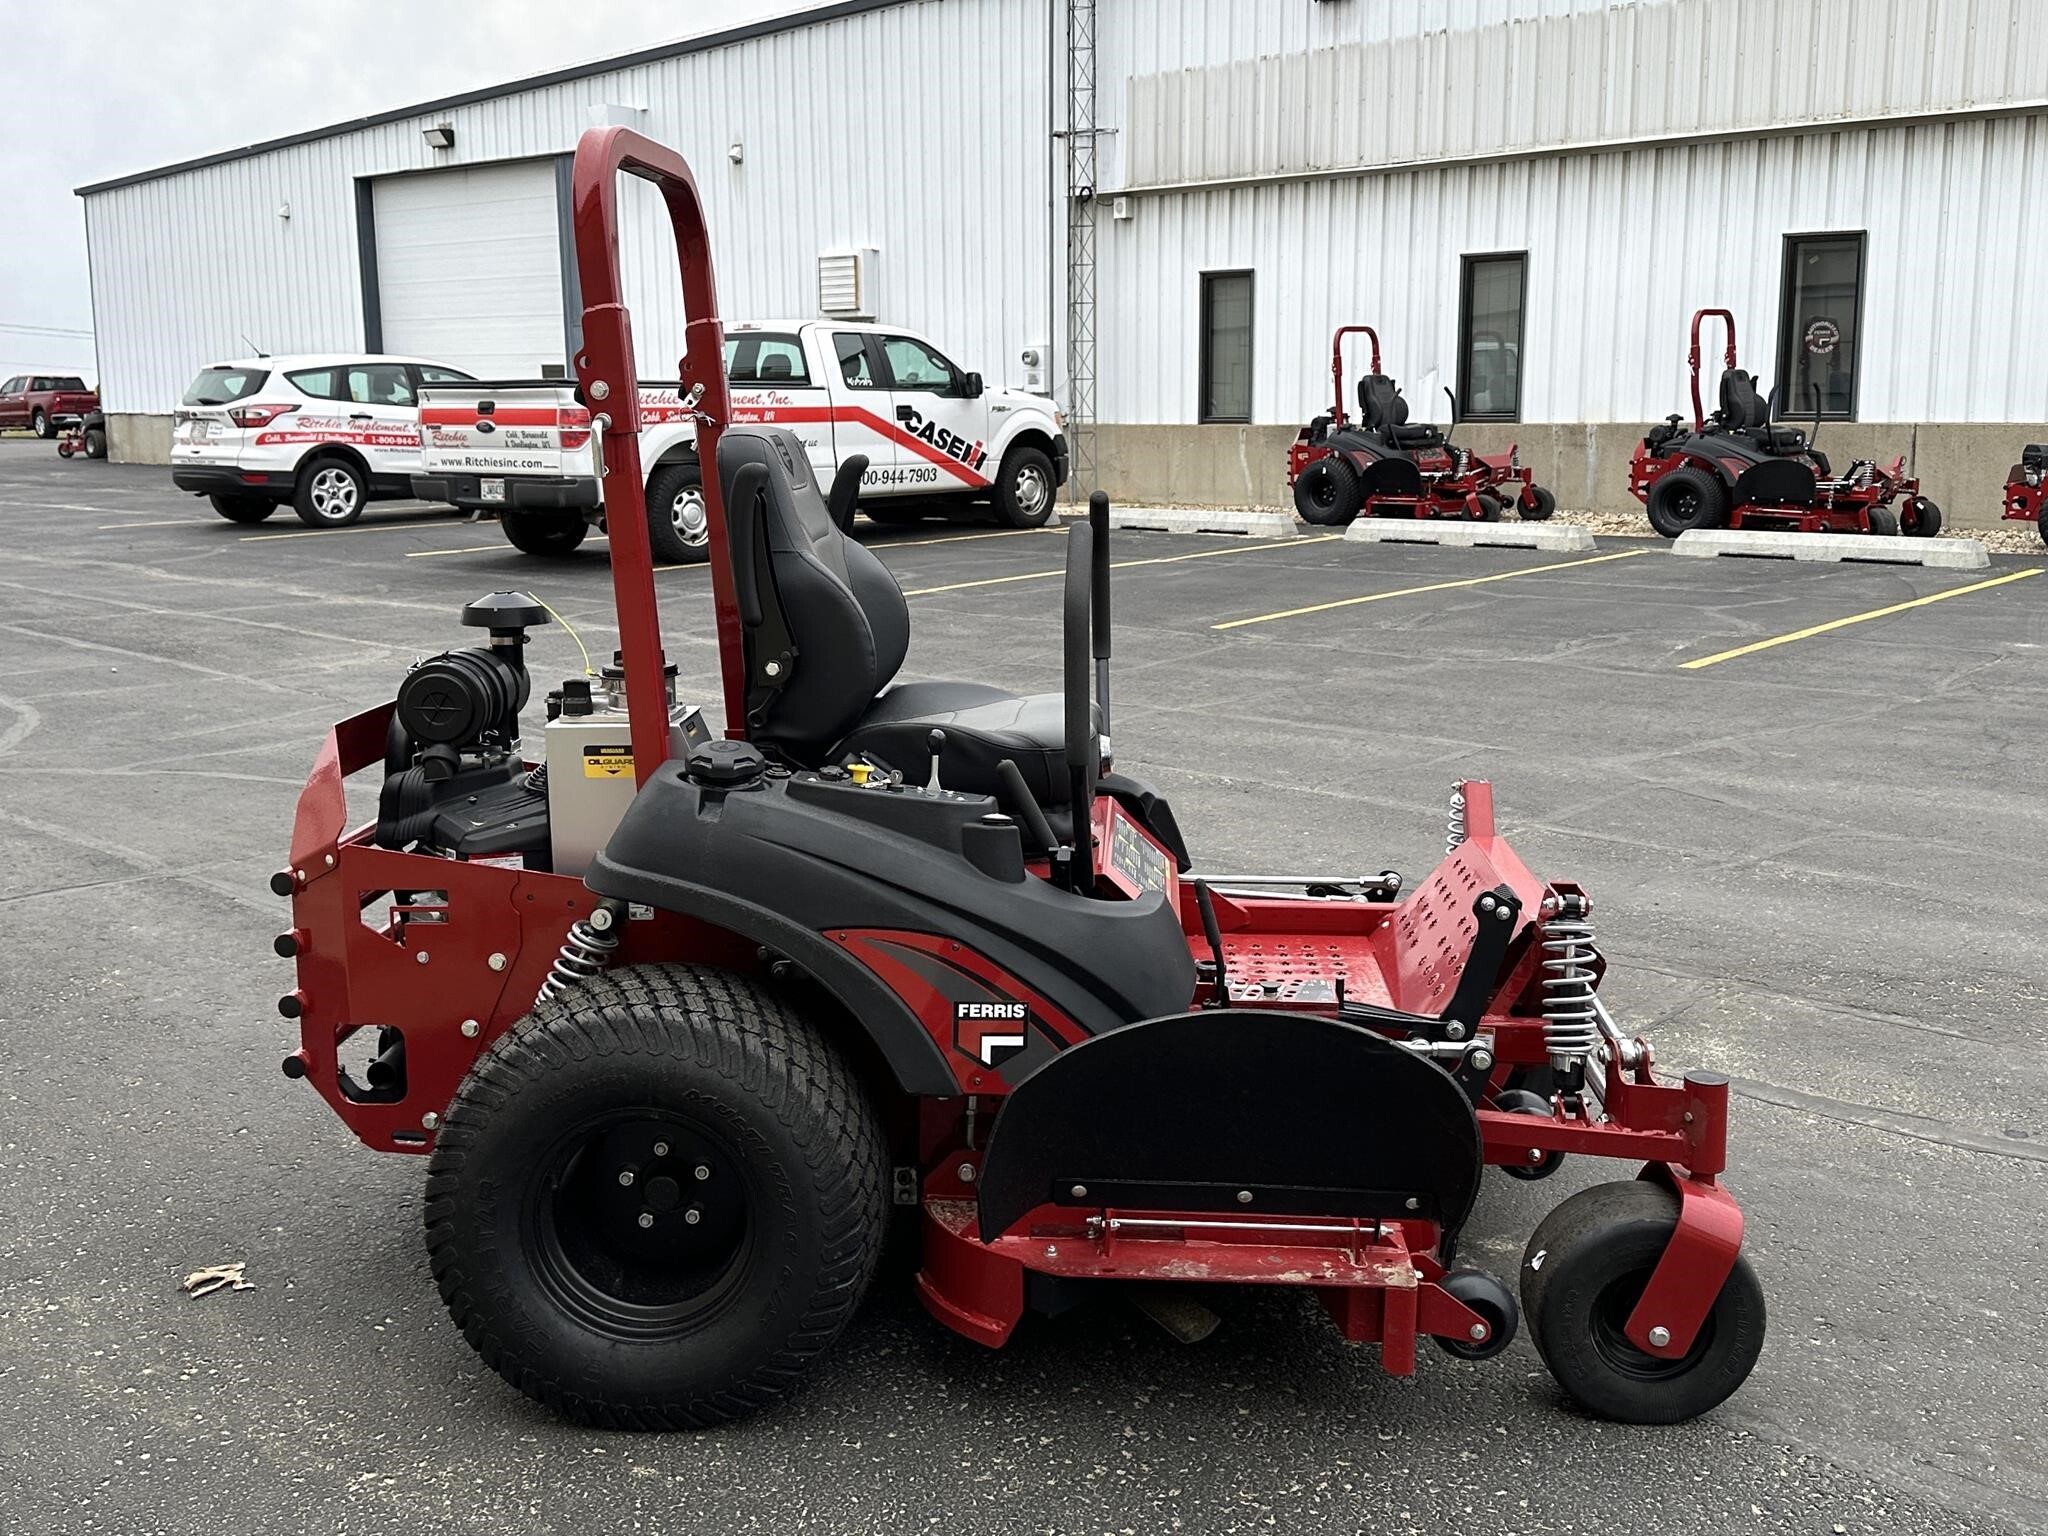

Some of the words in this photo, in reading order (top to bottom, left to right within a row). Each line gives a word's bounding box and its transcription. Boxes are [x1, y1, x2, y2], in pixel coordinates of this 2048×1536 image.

[1808, 321, 1839, 336] AUTHORIZED
[1809, 345, 1834, 354] DEALER
[638, 391, 679, 405] itchie
[767, 391, 793, 405] Inc.
[296, 417, 341, 429] Ritchie
[372, 436, 420, 445] 1-800-944-7
[432, 430, 468, 442] Ritchie
[440, 456, 543, 469] www.Ritchiesinc.com
[860, 468, 937, 486] 00-944-7903
[958, 1003, 1026, 1018] FERRIS
